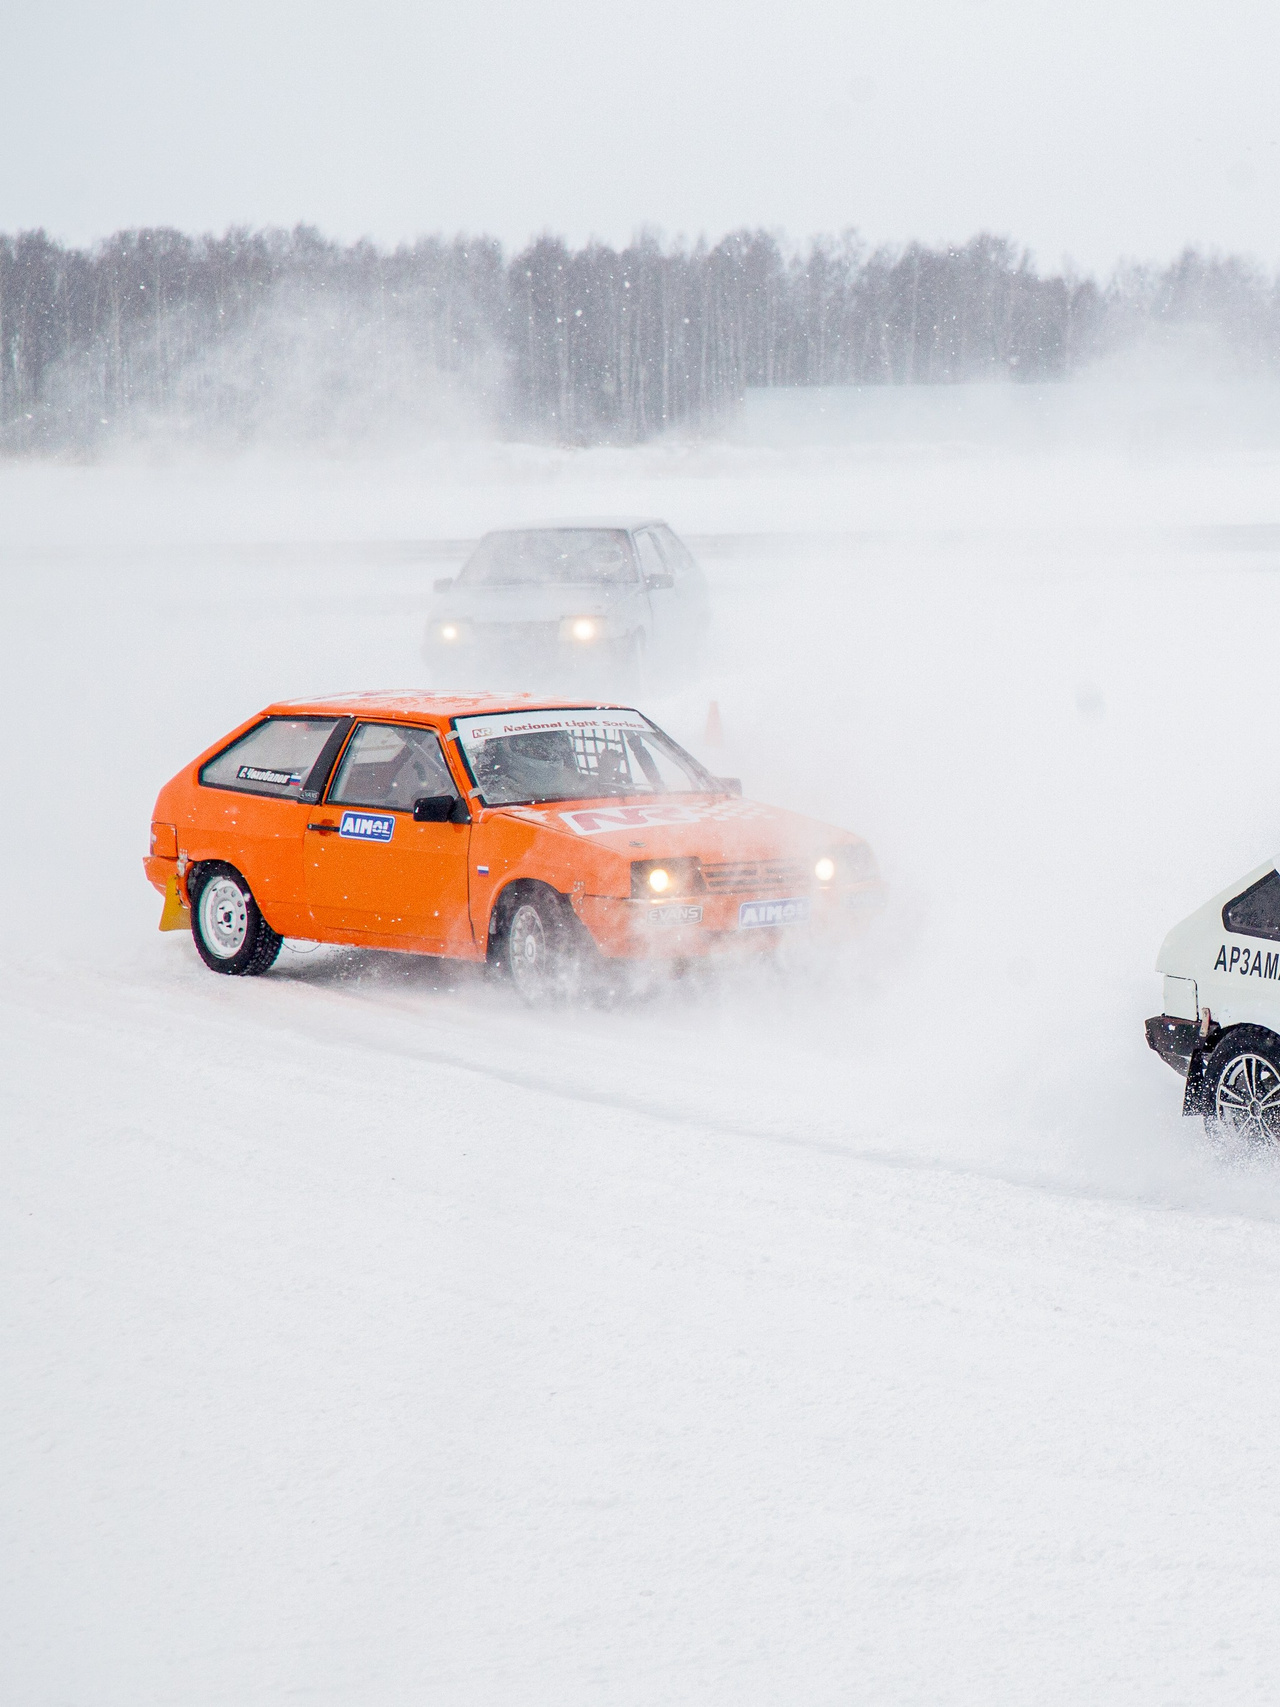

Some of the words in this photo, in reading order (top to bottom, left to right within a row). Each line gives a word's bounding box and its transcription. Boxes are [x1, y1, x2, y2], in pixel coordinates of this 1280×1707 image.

[503, 721, 563, 733] National
[566, 719, 600, 728] Light
[602, 720, 644, 729] Series
[341, 817, 391, 838] AIMOL
[649, 906, 699, 922] EVANS
